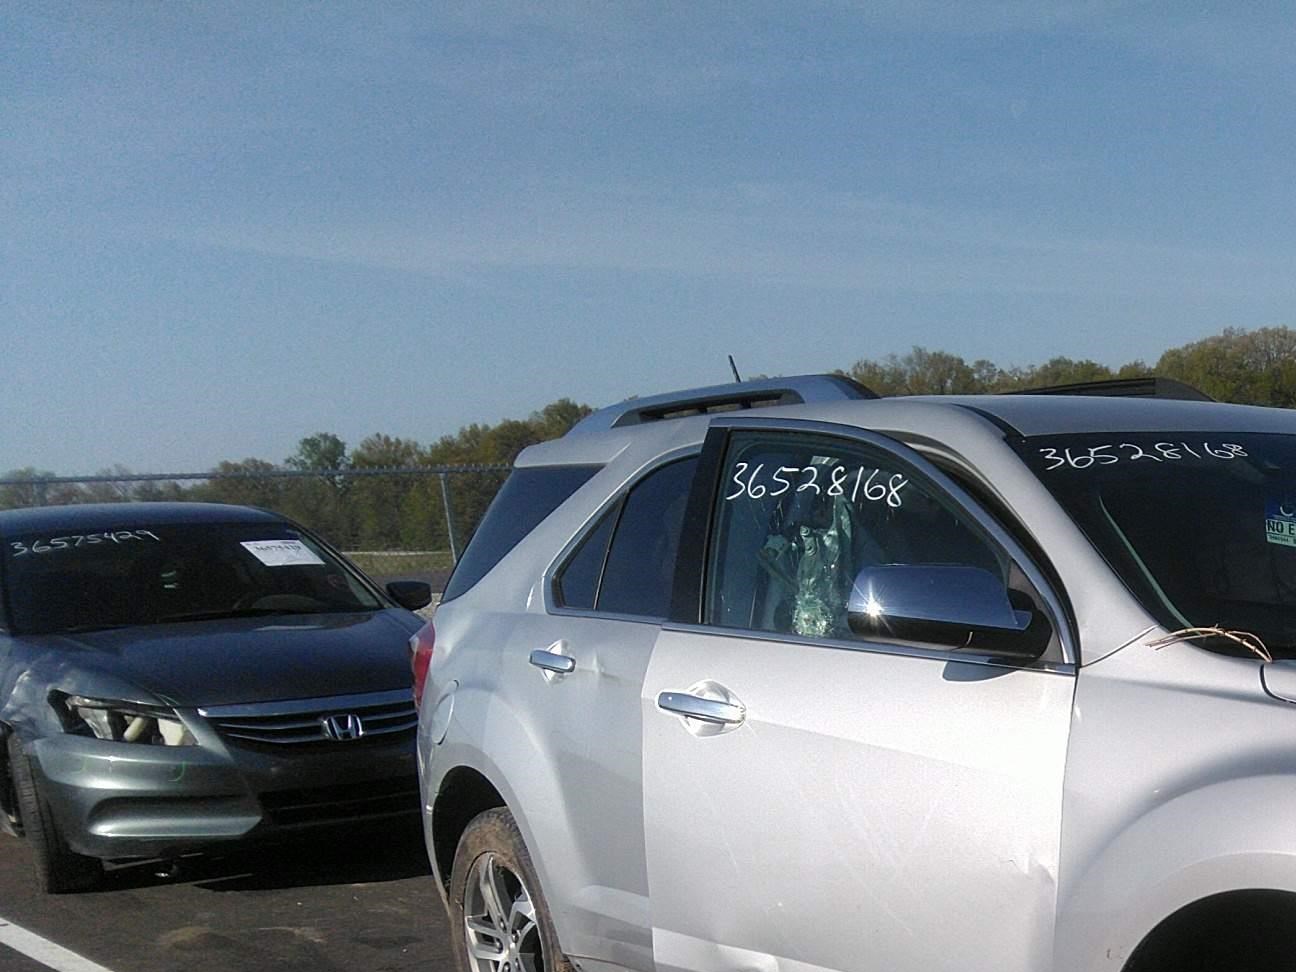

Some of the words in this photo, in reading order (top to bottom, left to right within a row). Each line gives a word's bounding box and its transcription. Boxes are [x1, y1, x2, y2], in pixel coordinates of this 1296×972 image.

[1039, 442, 1249, 471] 36528168
[725, 462, 909, 508] 36528168
[1267, 519, 1284, 534] NO
[10, 529, 161, 557] 36575429
